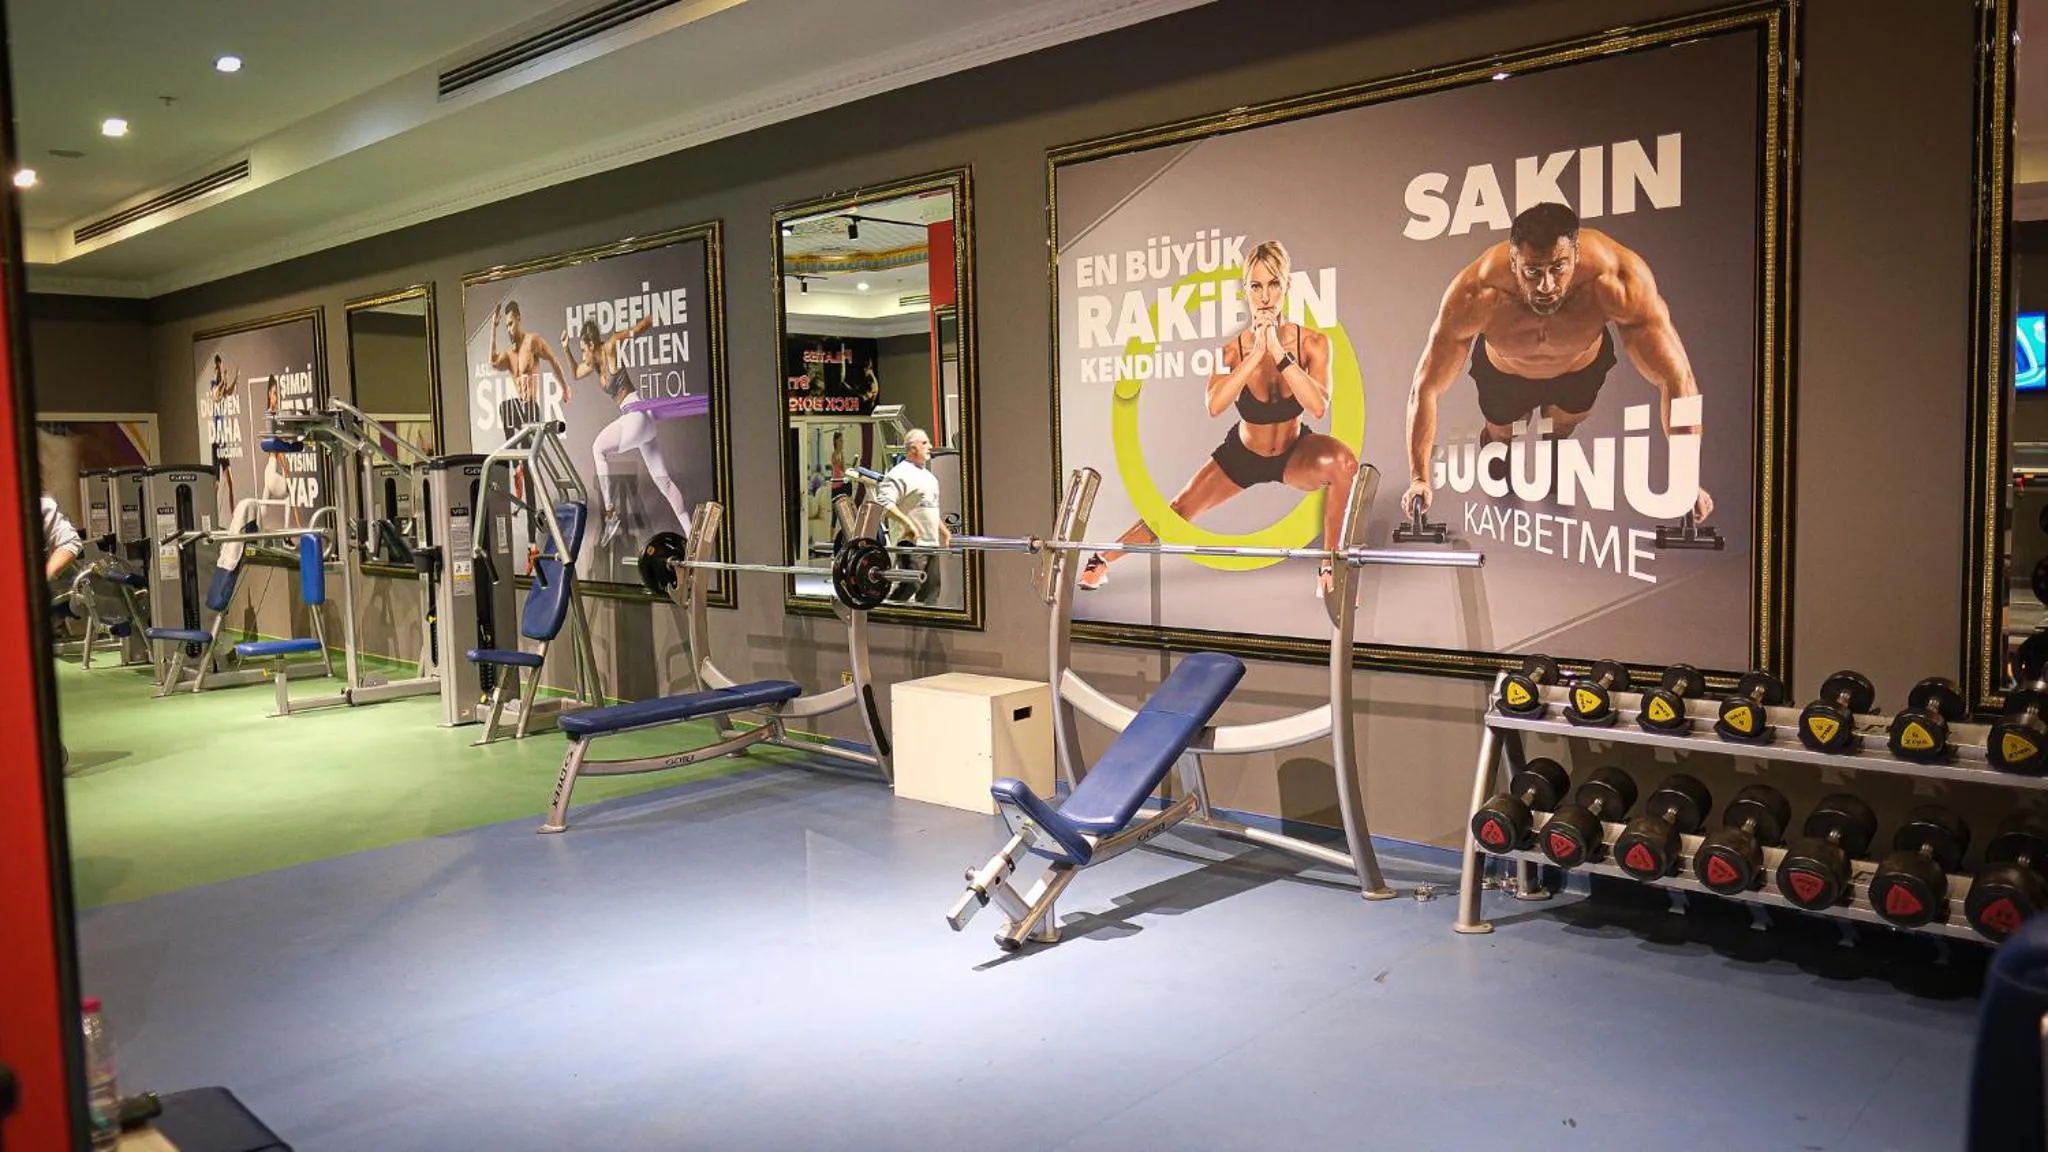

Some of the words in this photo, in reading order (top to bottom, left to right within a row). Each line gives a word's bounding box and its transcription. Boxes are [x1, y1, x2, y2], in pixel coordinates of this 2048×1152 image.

[1403, 132, 1681, 241] SAKIN
[1076, 253, 1118, 289] EN
[1126, 228, 1248, 283] BÜYÜK
[566, 281, 688, 339] HEDEFİNE
[1077, 267, 1338, 349] RAKİBN
[616, 330, 689, 368] KİTLEN
[1081, 344, 1185, 383] KENDİN
[1191, 347, 1231, 376] OL
[639, 368, 663, 399] FİT
[665, 370, 691, 398] OL
[207, 417, 242, 444] DAHA
[287, 477, 319, 508] YAP
[1464, 500, 1657, 583] KAYBETME
